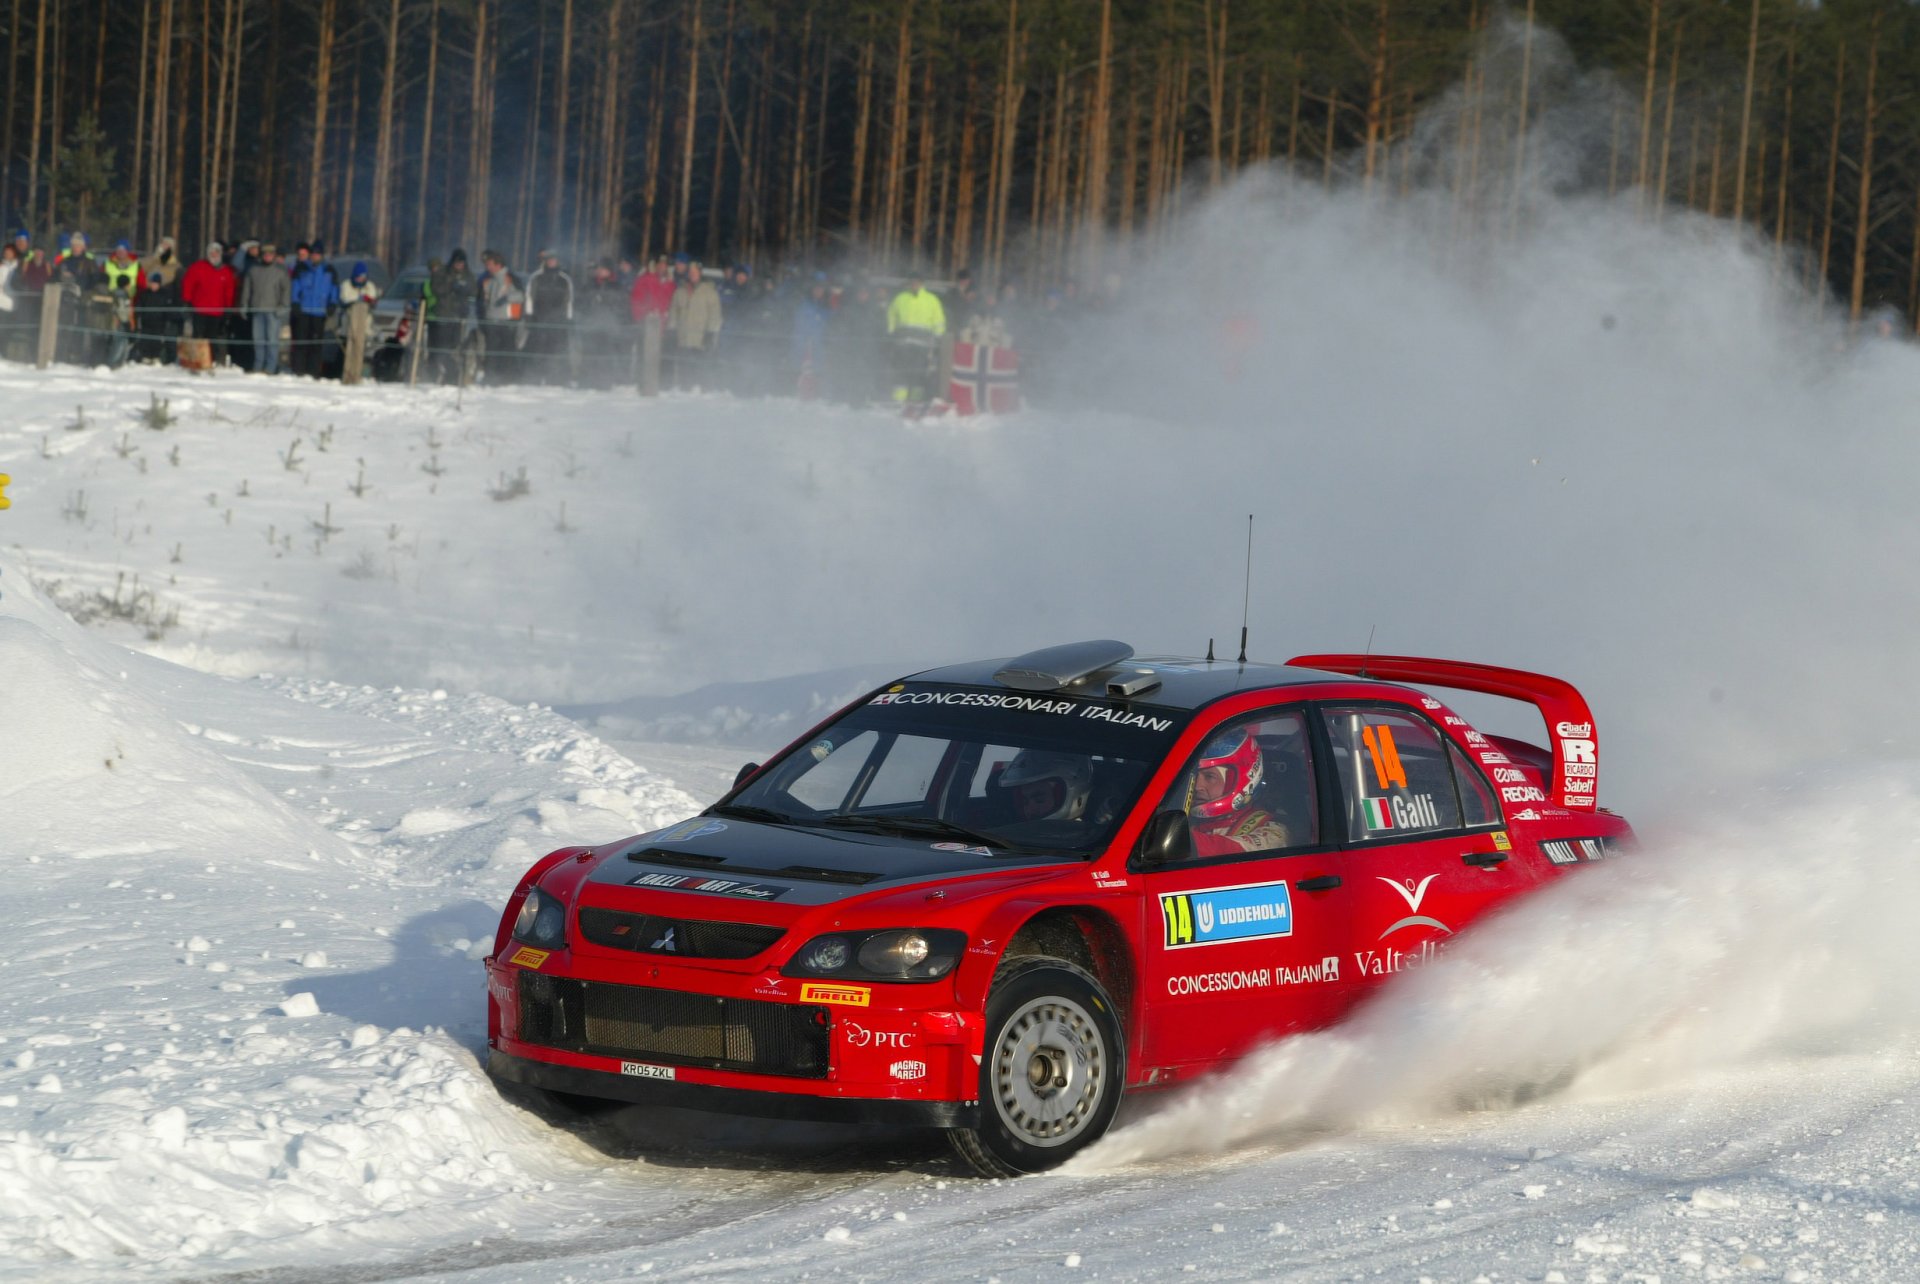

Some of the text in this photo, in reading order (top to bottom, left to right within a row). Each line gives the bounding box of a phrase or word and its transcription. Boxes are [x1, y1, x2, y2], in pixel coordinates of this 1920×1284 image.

[895, 692, 1173, 732] CONCESSIONARI ITALIANI
[1362, 724, 1408, 790] 14
[1561, 739, 1596, 762] R
[1567, 764, 1594, 775] RICARDO
[1502, 786, 1545, 802] RECARO
[1564, 777, 1594, 793] Sabelt
[1392, 794, 1439, 829] Galli
[1543, 841, 1578, 863] RALLI
[634, 874, 690, 887] RALLI
[695, 880, 741, 892] ART
[1165, 895, 1192, 945] 14
[1218, 902, 1287, 925] UDDEHOLM
[1354, 940, 1446, 976] Valtelli
[1167, 963, 1322, 995] CONCESSIONARI ITALIANI
[807, 987, 865, 1003] PIRELLI
[874, 1032, 912, 1048] PTC
[623, 1063, 673, 1079] KR05 ZKL
